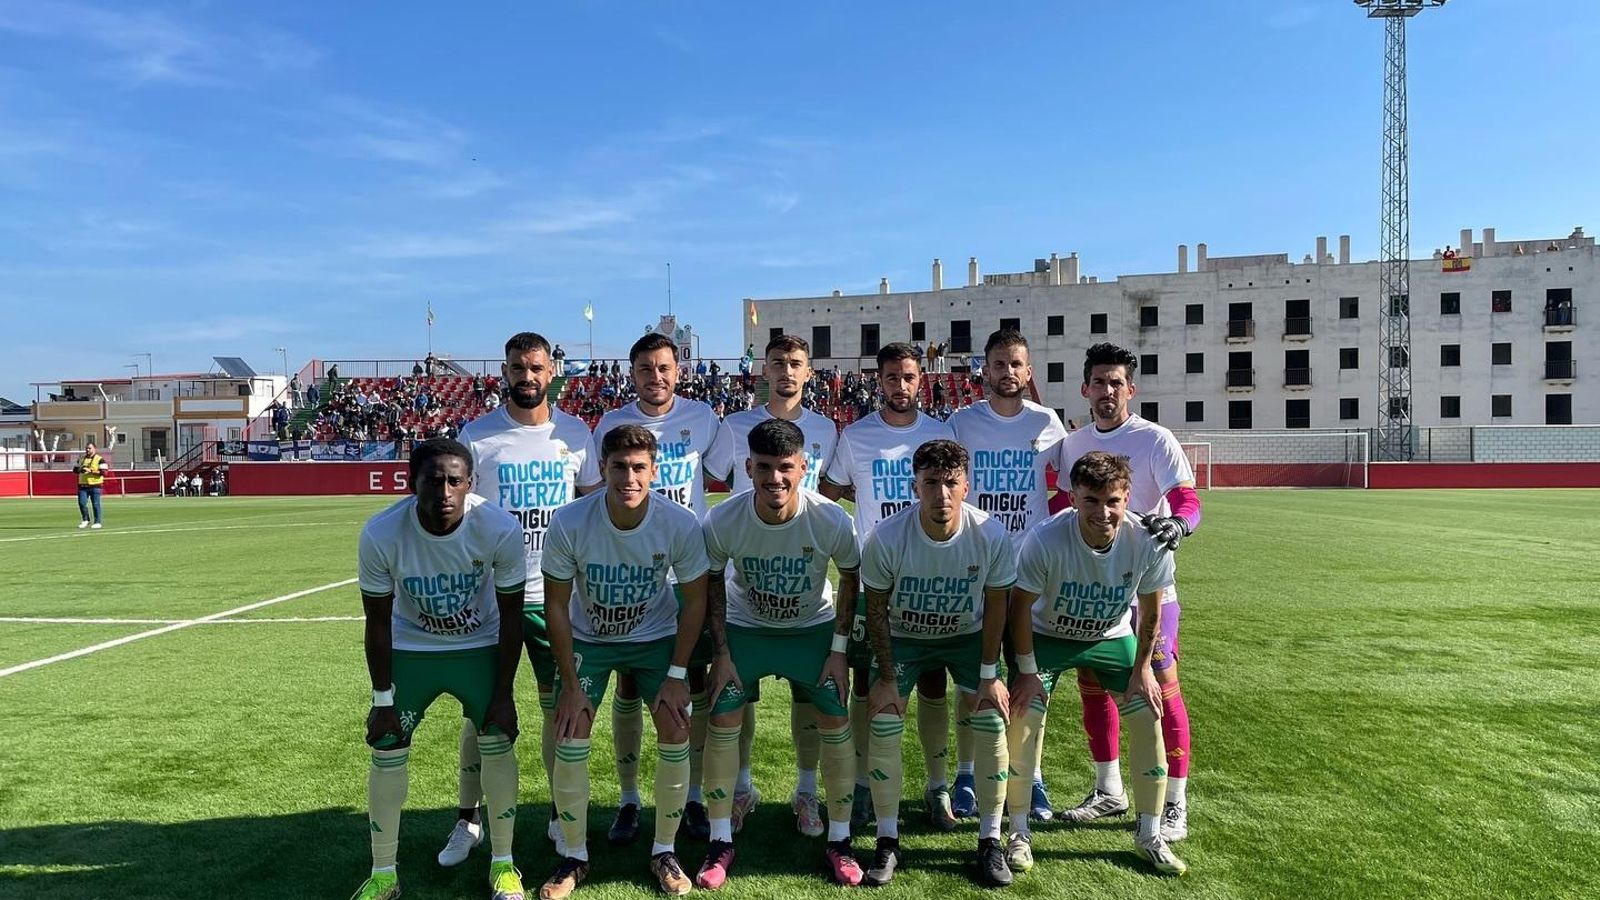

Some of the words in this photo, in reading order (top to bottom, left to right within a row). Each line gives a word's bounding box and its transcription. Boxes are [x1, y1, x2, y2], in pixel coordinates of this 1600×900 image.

[873, 458, 912, 477] MUC
[974, 449, 1034, 468] MUCHA
[498, 460, 564, 483] MUCHA
[974, 469, 1036, 491] FUERZA
[499, 482, 567, 508] FUERZA
[979, 493, 1028, 512] MIGUE
[508, 508, 556, 530] IGU
[587, 563, 655, 583] MUCHA
[742, 556, 806, 575] MUCHA
[403, 573, 477, 596] MUCHA
[587, 581, 657, 606] FUERZA
[744, 571, 812, 595] FUERZA
[900, 576, 969, 594] MUCHA
[1060, 581, 1125, 602] MUCHA
[592, 602, 647, 622] MIGUE
[896, 592, 974, 613] FUERZA
[1053, 597, 1130, 620] FUERZA
[902, 611, 960, 626] MIGUE
